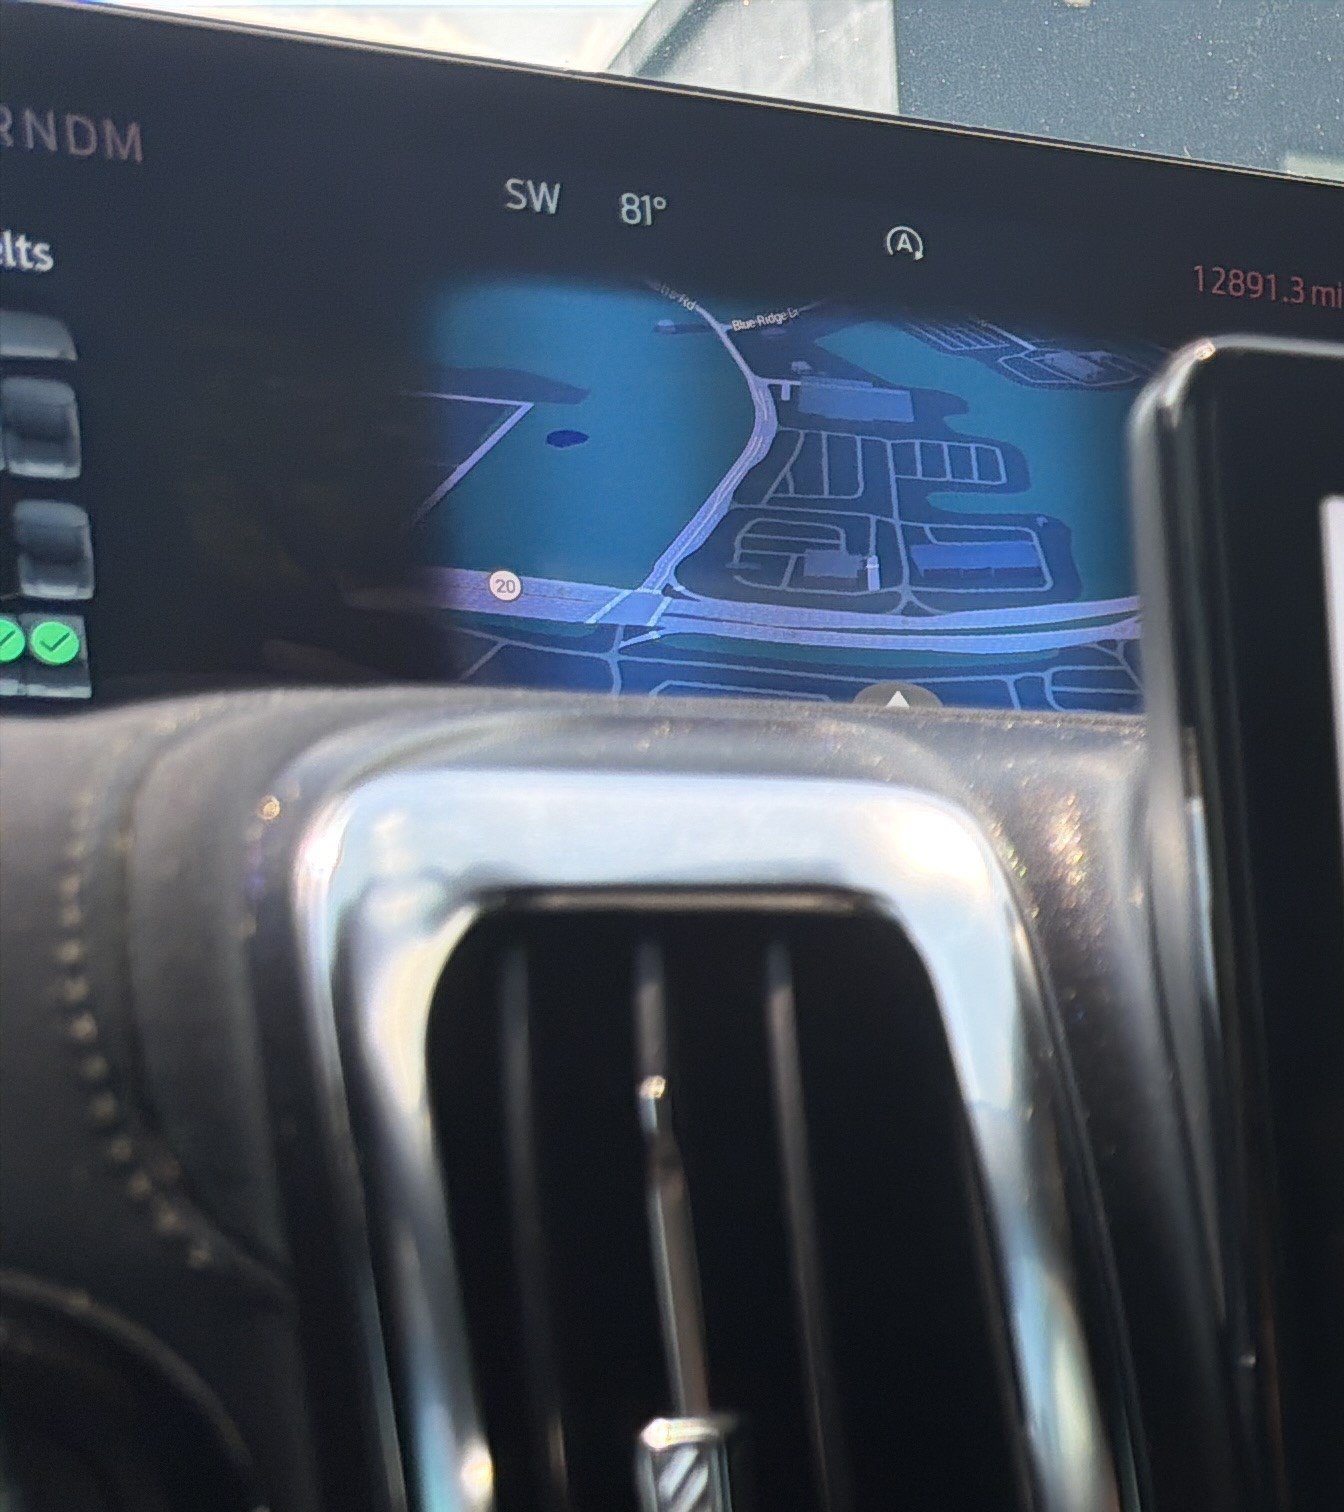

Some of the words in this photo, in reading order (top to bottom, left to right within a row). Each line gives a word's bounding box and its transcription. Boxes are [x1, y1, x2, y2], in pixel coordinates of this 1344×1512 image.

[504, 177, 561, 215] SW
[619, 191, 667, 227] 81°
[1193, 265, 1305, 304] 12891.3
[1311, 281, 1343, 309] mi
[731, 318, 756, 332] Blue
[757, 312, 787, 325] Ridge
[495, 578, 516, 594] 20
